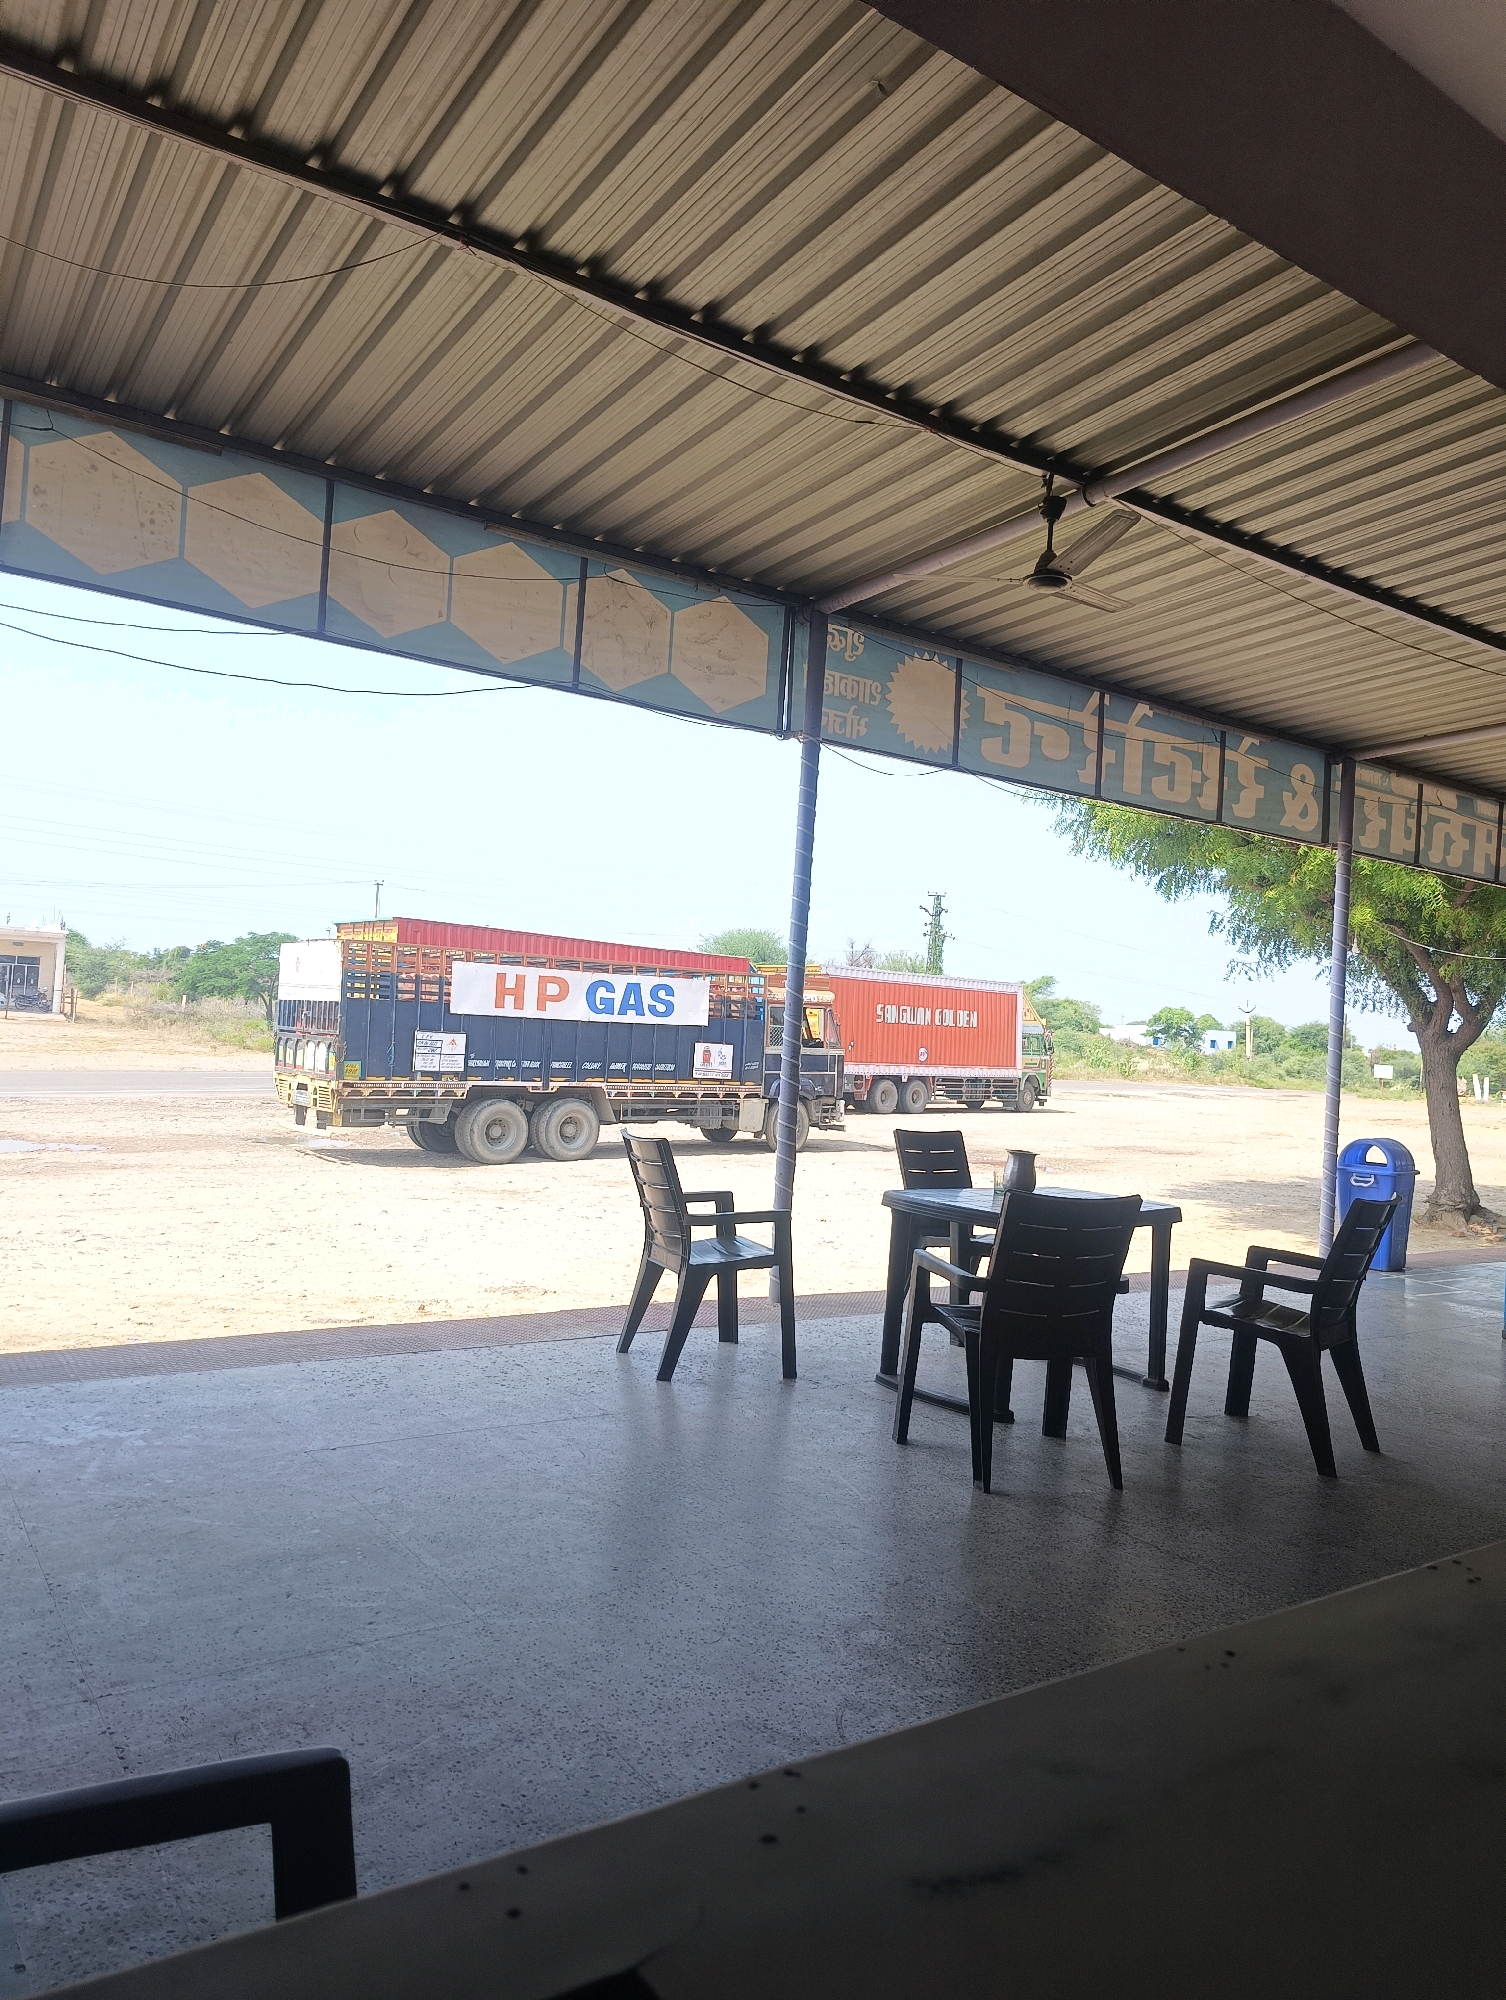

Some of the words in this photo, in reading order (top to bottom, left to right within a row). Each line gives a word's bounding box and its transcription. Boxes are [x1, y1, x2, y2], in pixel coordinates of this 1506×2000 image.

[494, 972, 570, 1013] HP
[585, 979, 676, 1019] GAS
[934, 1008, 979, 1029] GOLDEN
